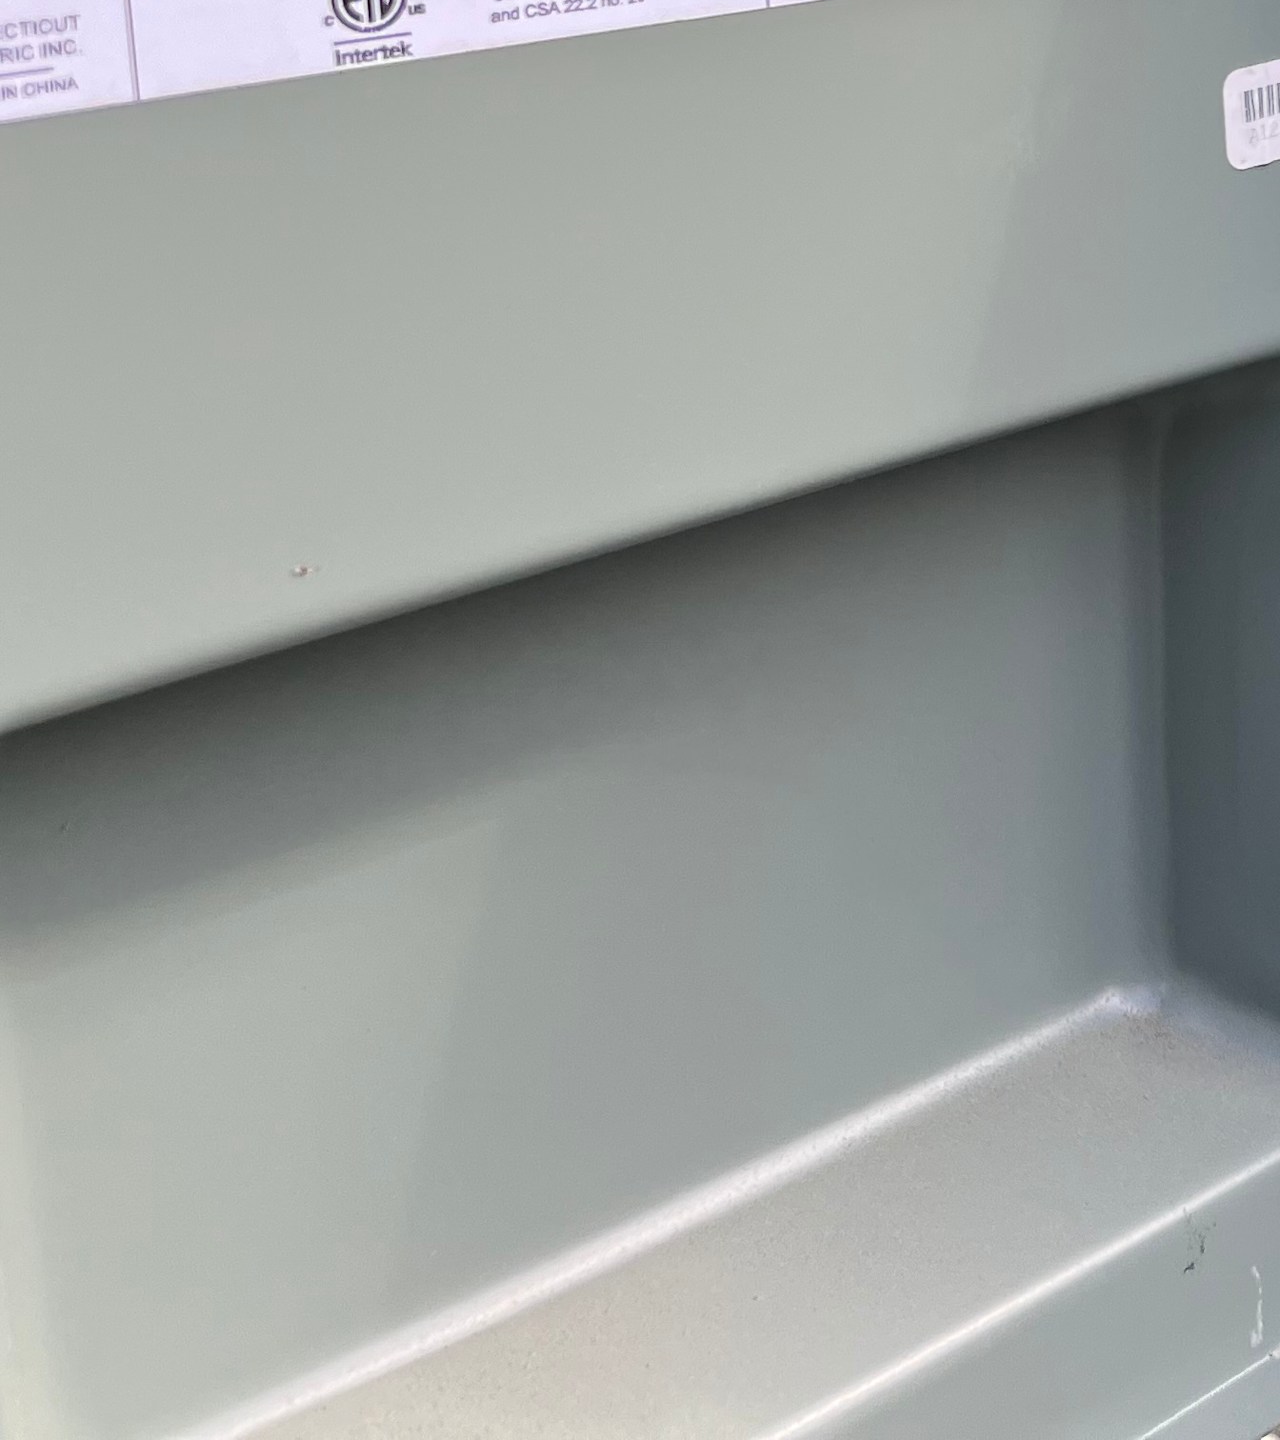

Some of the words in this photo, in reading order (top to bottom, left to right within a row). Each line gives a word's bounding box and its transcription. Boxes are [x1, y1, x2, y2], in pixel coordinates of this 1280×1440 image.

[490, 6, 520, 24] and
[523, 0, 561, 19] CSA
[334, 40, 413, 67] Intertek
